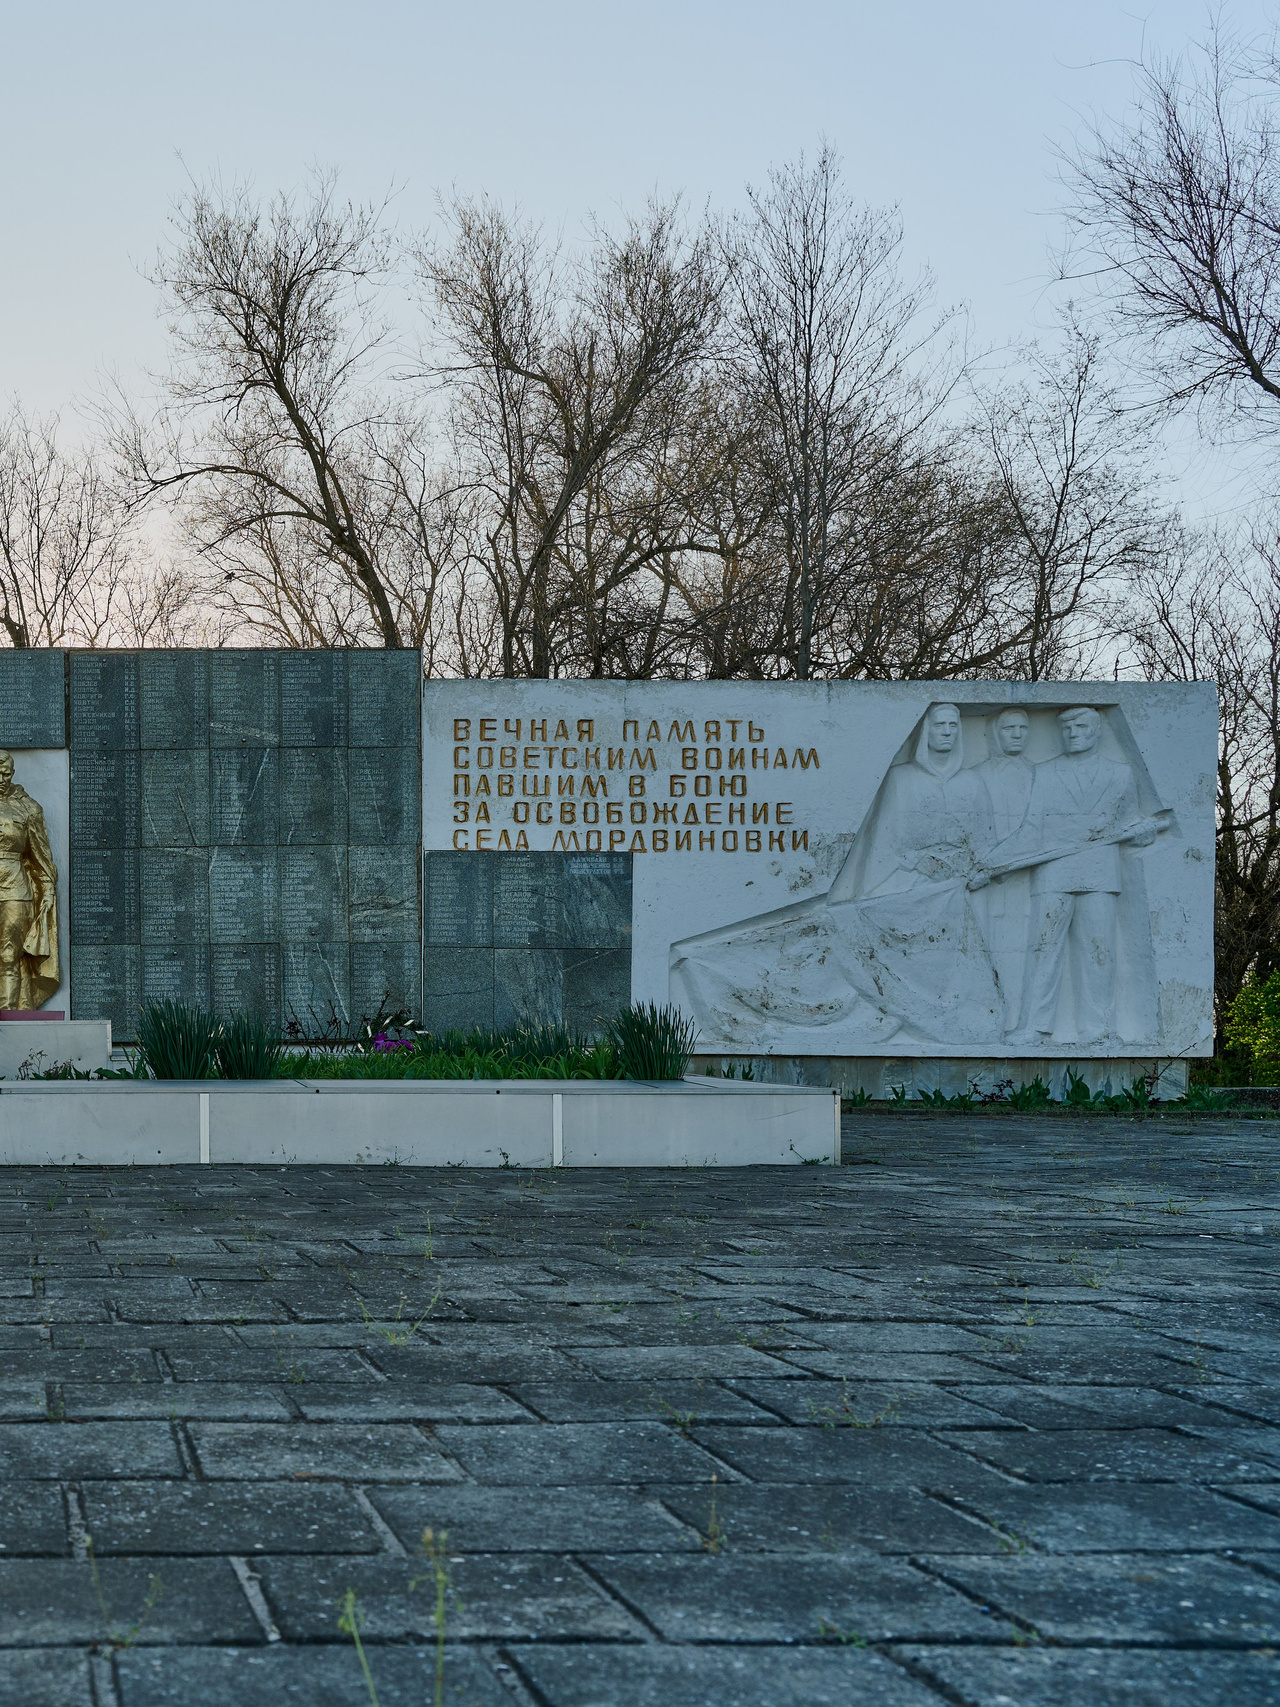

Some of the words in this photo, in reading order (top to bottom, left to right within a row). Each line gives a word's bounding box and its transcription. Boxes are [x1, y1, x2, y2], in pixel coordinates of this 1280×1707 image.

[453, 718, 595, 742] ВЕЧНАЯ
[623, 719, 765, 743] ПАМЯТЬ
[453, 746, 658, 771] СОВЕТСКИМ
[682, 747, 820, 771] ВОИНАМ
[453, 774, 609, 798] ПАВШИМ
[628, 775, 646, 798] В
[670, 775, 748, 798] БОЮ
[452, 802, 491, 825] ЗА
[513, 802, 794, 826] ОСВОБОЖДЕНИЕ
[451, 829, 529, 851] СЕЛА
[552, 830, 810, 854] МОРДВИНОВКИ
